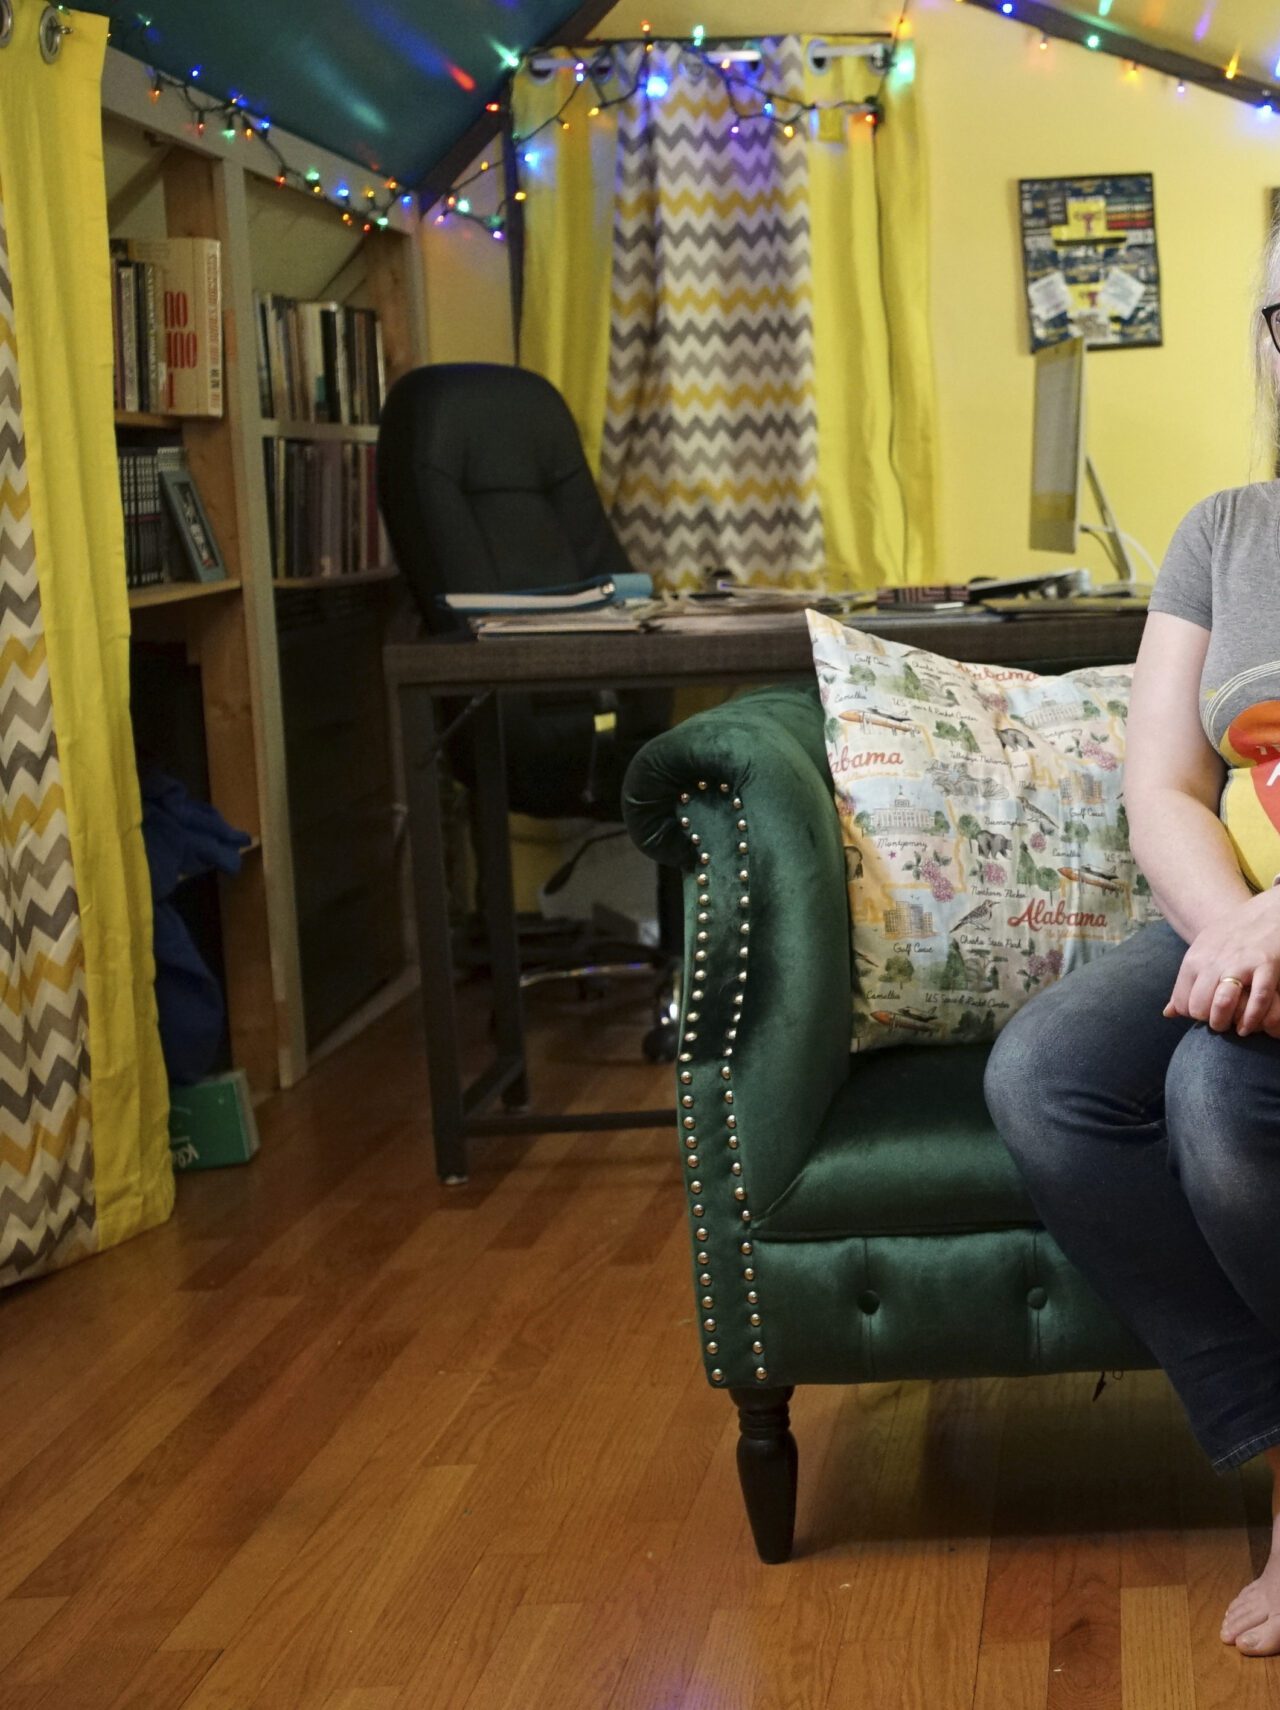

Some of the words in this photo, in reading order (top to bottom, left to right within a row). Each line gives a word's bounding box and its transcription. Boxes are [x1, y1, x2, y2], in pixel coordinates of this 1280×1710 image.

[954, 663, 1040, 682] abama
[827, 745, 904, 774] abama
[1007, 897, 1108, 932] Alabama
